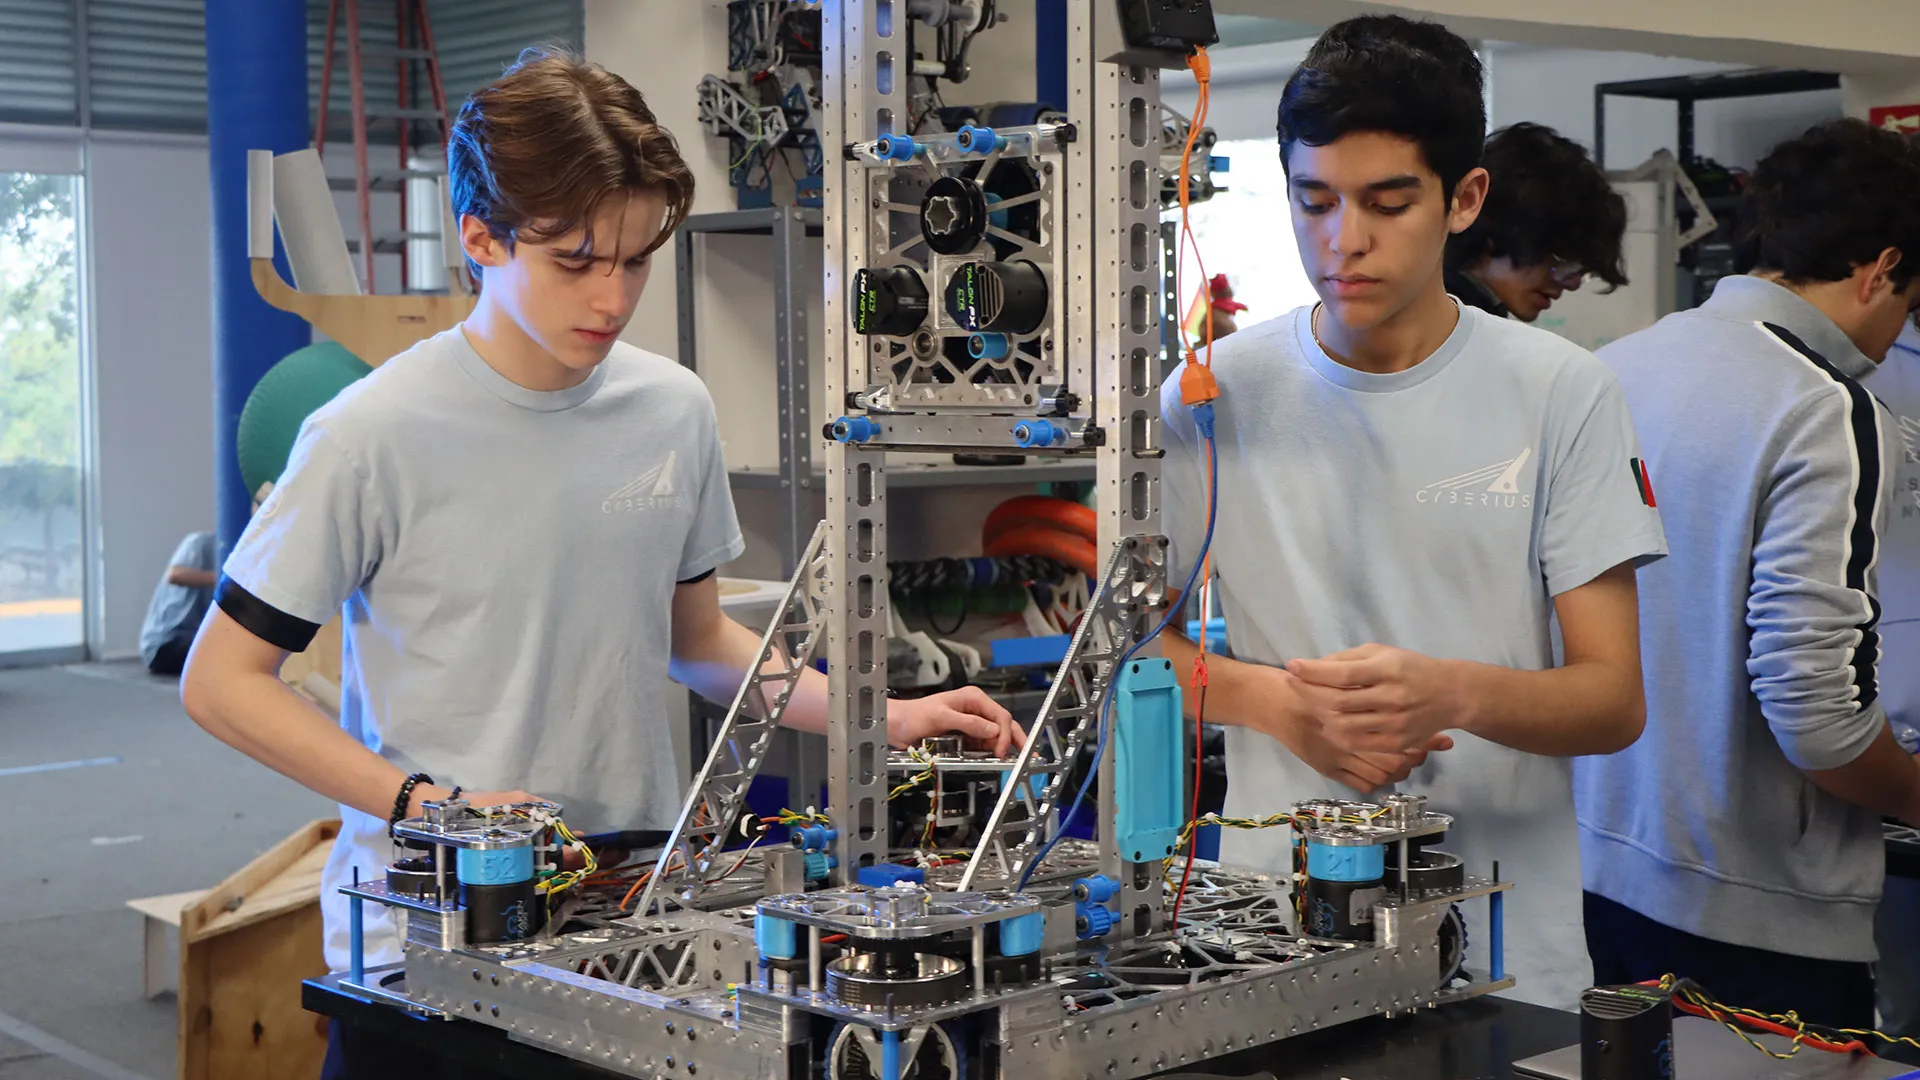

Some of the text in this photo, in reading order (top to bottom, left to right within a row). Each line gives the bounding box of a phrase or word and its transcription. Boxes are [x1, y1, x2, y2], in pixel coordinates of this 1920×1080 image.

[860, 272, 867, 293] FX
[966, 265, 977, 328] TALON FX
[482, 853, 517, 880] 52
[1328, 852, 1357, 877] 21
